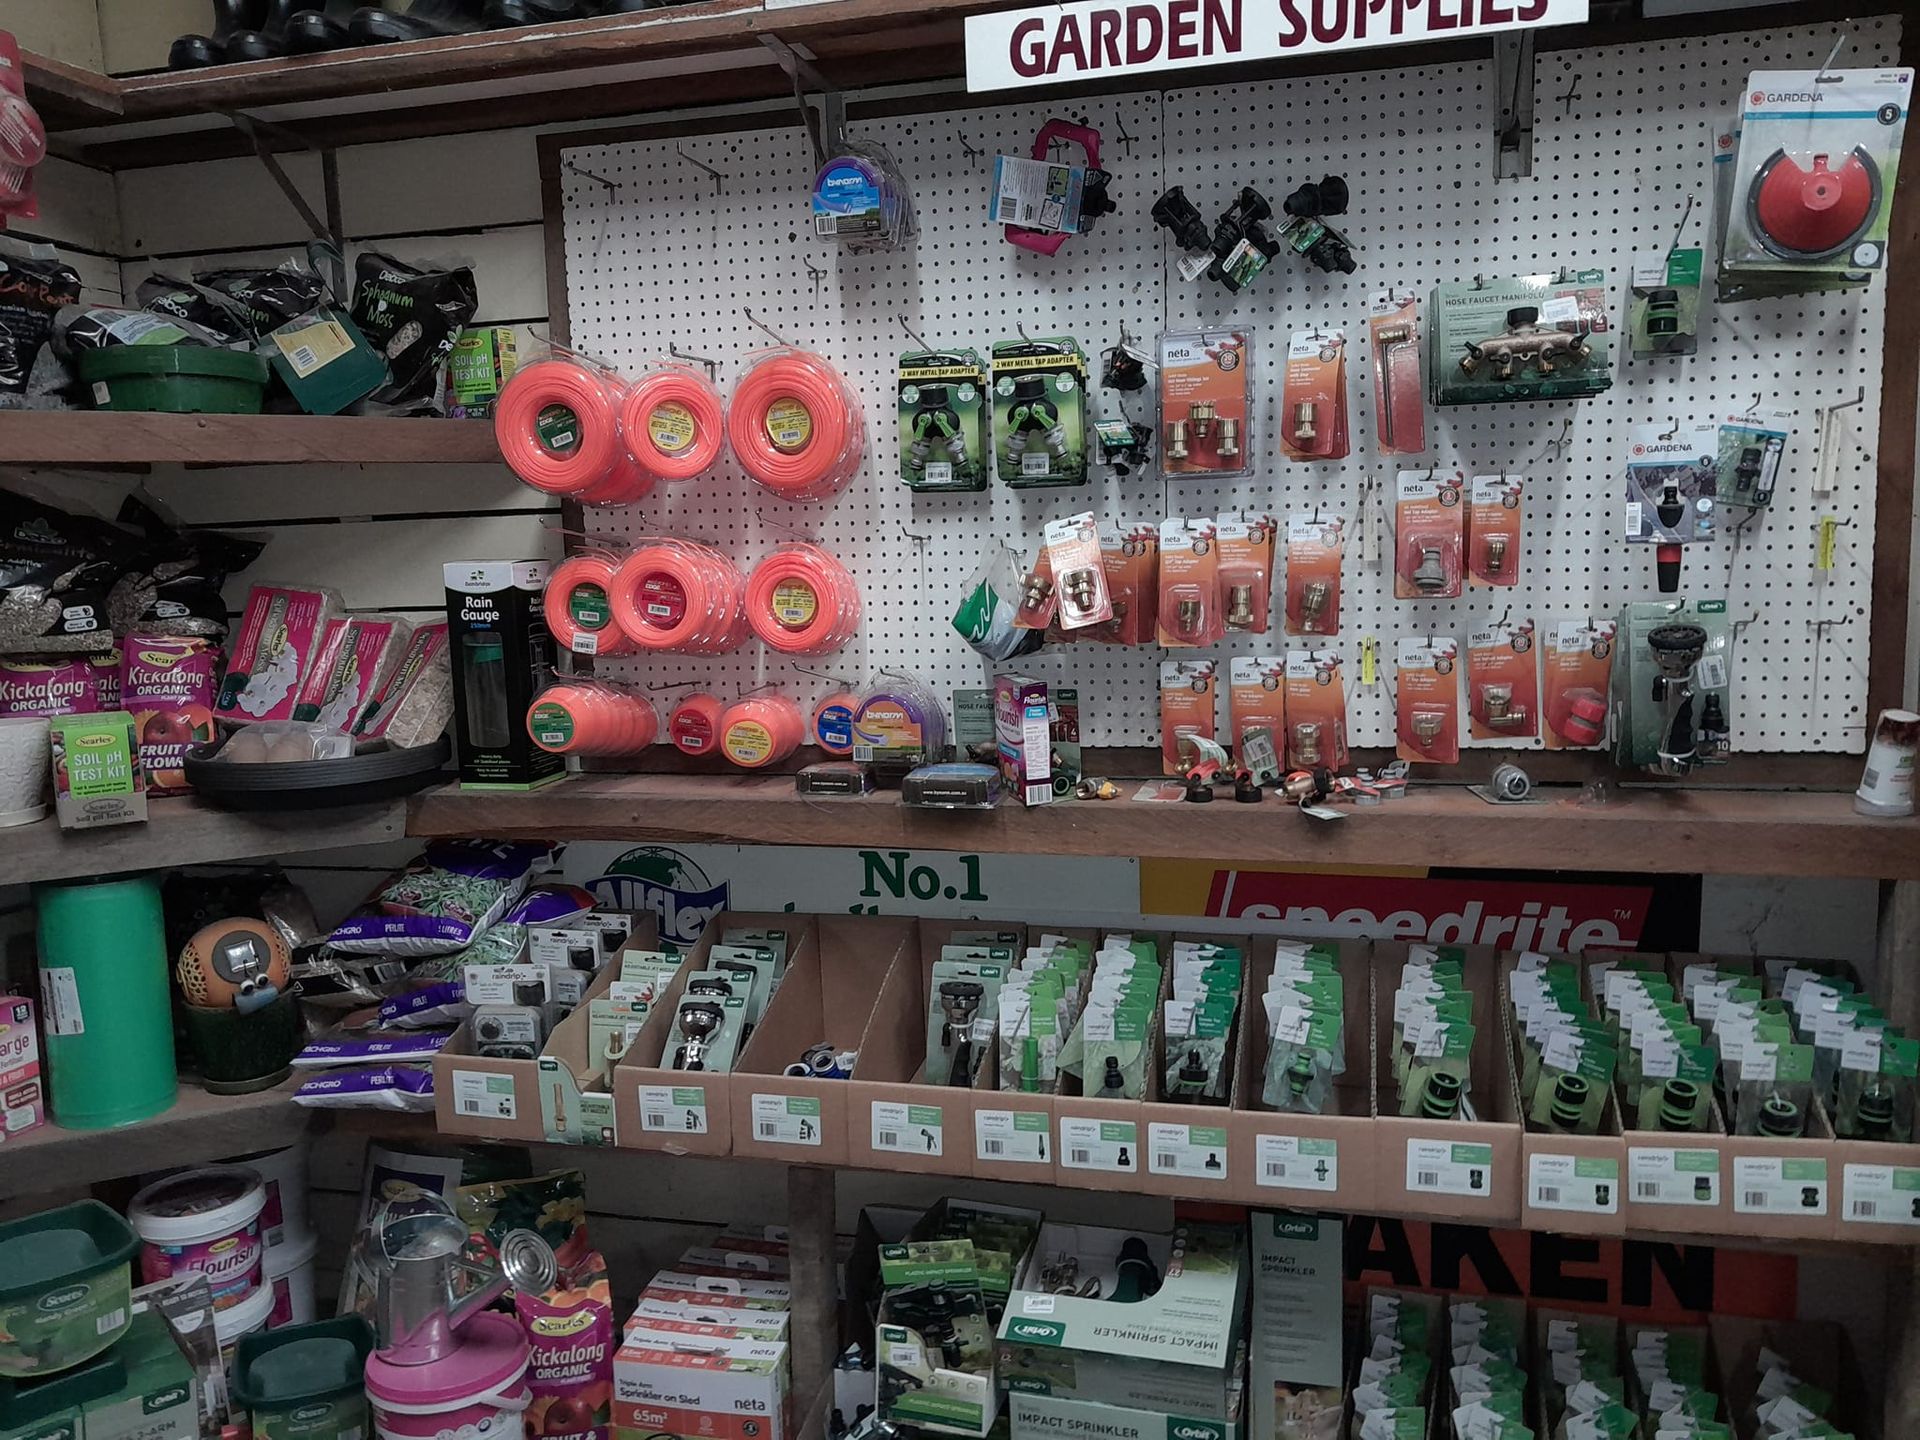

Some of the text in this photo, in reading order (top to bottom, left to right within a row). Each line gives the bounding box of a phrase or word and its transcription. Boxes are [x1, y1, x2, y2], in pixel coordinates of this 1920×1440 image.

[1009, 0, 1242, 77] GARDEN
[1767, 93, 1823, 103] GARDENA
[366, 305, 394, 329] Moss
[1168, 349, 1190, 358] neta
[455, 355, 474, 366] SOIL
[1015, 359, 1033, 367] METAL
[1047, 356, 1075, 365] ADAPTER
[455, 369, 474, 380] TEST
[920, 369, 938, 377] METAL
[950, 367, 976, 375] ADAPTER
[1647, 443, 1692, 453] GARDENA
[1404, 484, 1424, 492] neta
[1050, 531, 1065, 540] neta
[1293, 527, 1310, 535] neta
[465, 596, 493, 608] Rain
[461, 609, 500, 622] Gauge
[1472, 633, 1491, 641] neta
[1562, 637, 1579, 645] neta
[146, 653, 173, 664] Sear
[1405, 653, 1422, 661] neta
[128, 666, 204, 688] Kickalong
[0, 680, 84, 700] Kickalong
[137, 685, 191, 696] ORGANIC
[10, 697, 71, 712] ORGANIC
[80, 735, 111, 745] Searles
[141, 744, 180, 756] FRUIT
[74, 751, 122, 766] SOIL pH
[74, 765, 127, 781] TEST KIT
[858, 850, 988, 900] No.1
[595, 881, 725, 942] Allflex
[1239, 901, 1638, 953] edrite
[492, 973, 521, 981] raindrip
[1261, 1254, 1296, 1264] IMPACT
[1347, 1215, 1714, 1312] AKEN
[1261, 1264, 1316, 1275] SPRINKLER
[764, 1287, 788, 1296] neta
[755, 1317, 779, 1325] neta
[1024, 1324, 1052, 1336] Orbit
[1094, 1327, 1218, 1351] IMPACT SPRINKLER
[529, 1343, 605, 1366] Kickalong
[750, 1348, 776, 1356] neta
[536, 1362, 591, 1379] ORGANIC
[619, 1387, 700, 1406] Sprinkler on Sled
[735, 1399, 766, 1411] neta
[1018, 1413, 1139, 1439] IMPACT SPRINKLER
[1180, 1426, 1211, 1439] Orbit
